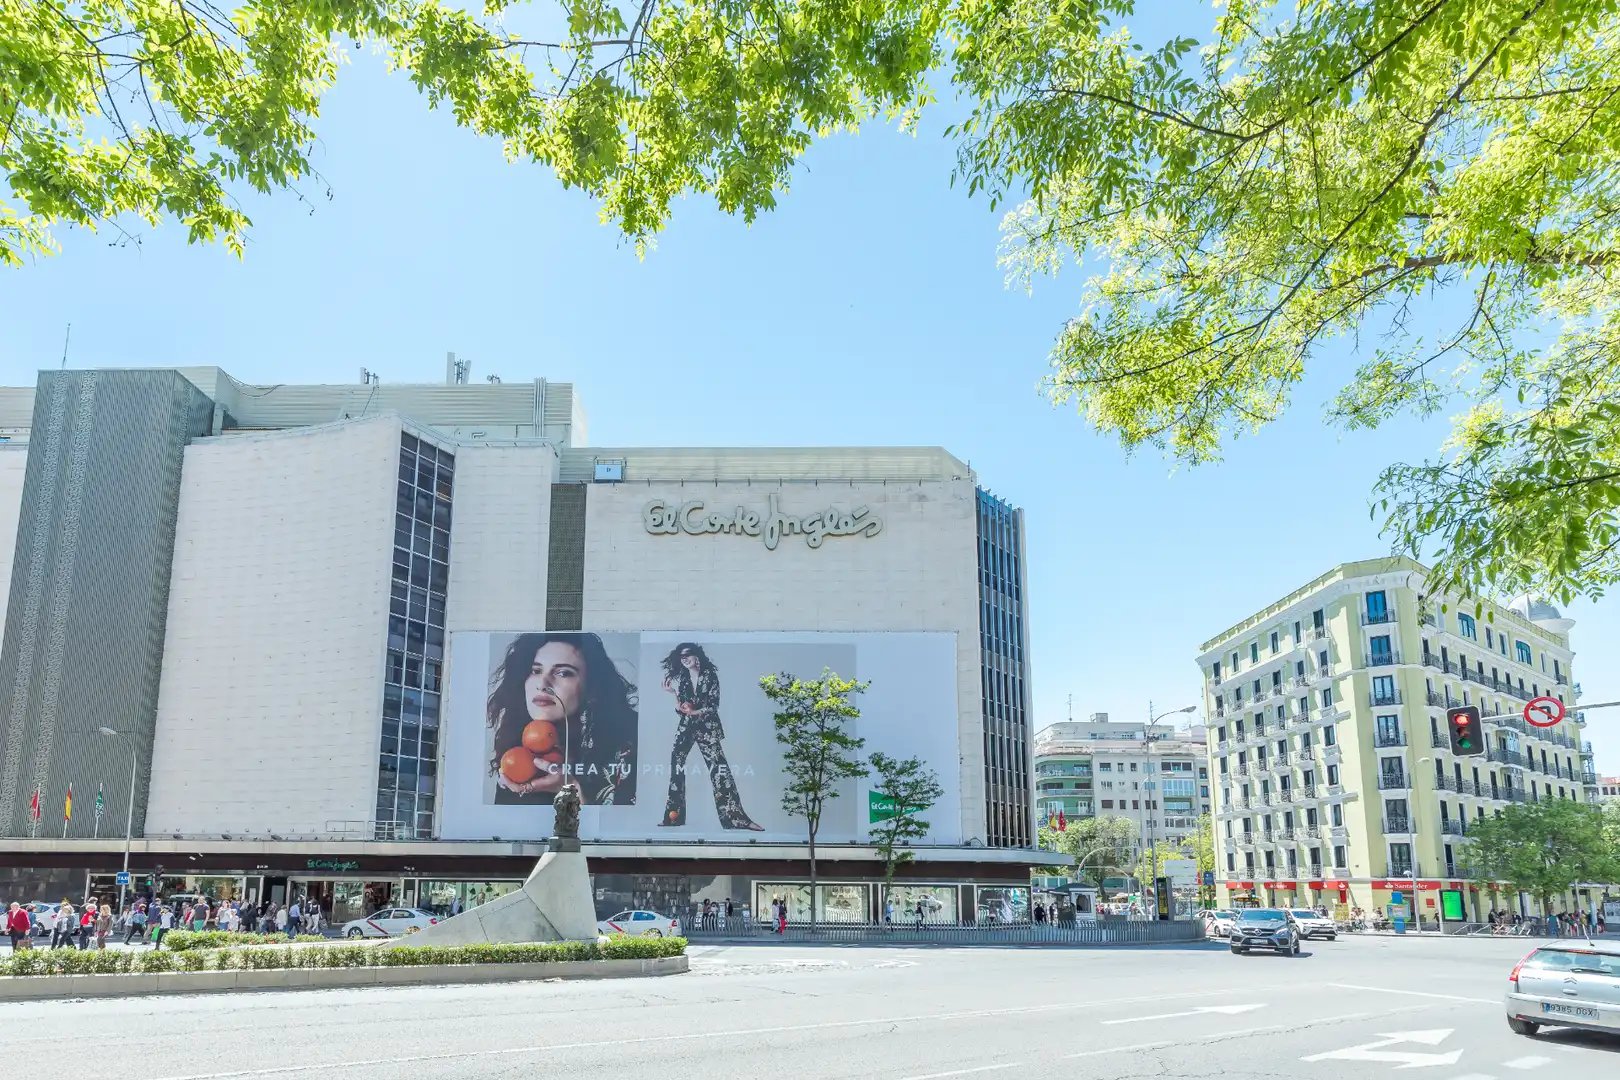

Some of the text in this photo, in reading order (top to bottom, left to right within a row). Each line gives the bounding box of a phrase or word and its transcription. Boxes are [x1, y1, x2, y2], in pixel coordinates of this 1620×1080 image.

[644, 493, 883, 550] El Corte Inglés
[549, 763, 755, 776] CREA TU PRIMAVERA
[871, 802, 879, 810] El
